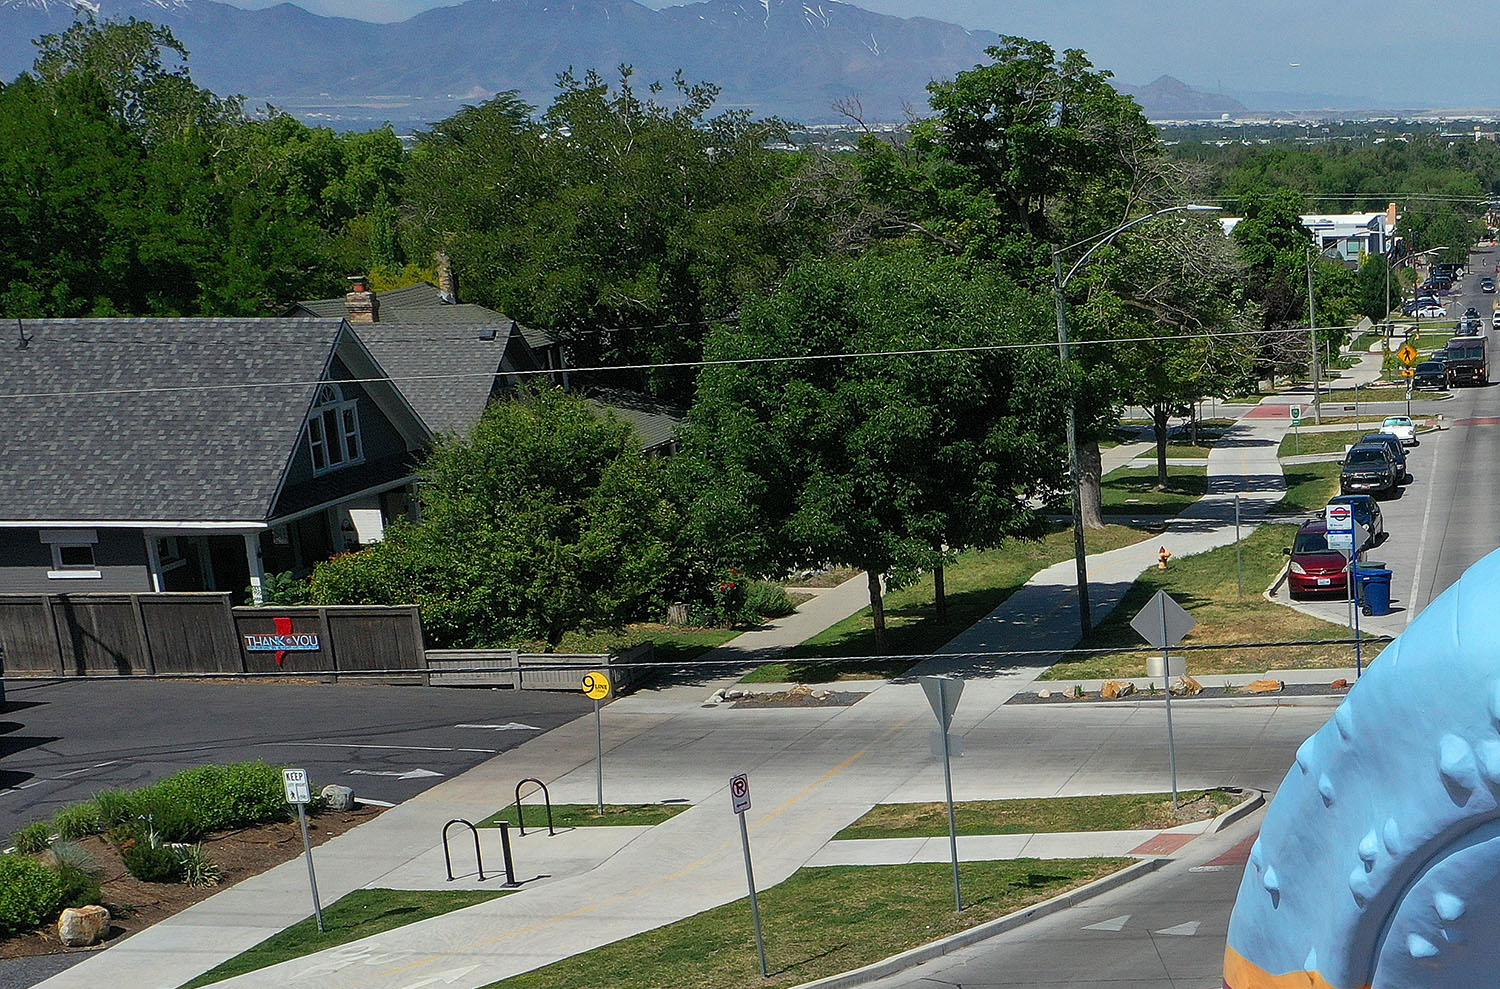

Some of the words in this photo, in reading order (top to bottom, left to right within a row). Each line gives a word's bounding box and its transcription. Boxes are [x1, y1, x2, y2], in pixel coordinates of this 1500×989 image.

[244, 635, 286, 647] THANK
[292, 635, 318, 646] YOU
[582, 676, 595, 693] 9
[286, 772, 303, 781] KEEP
